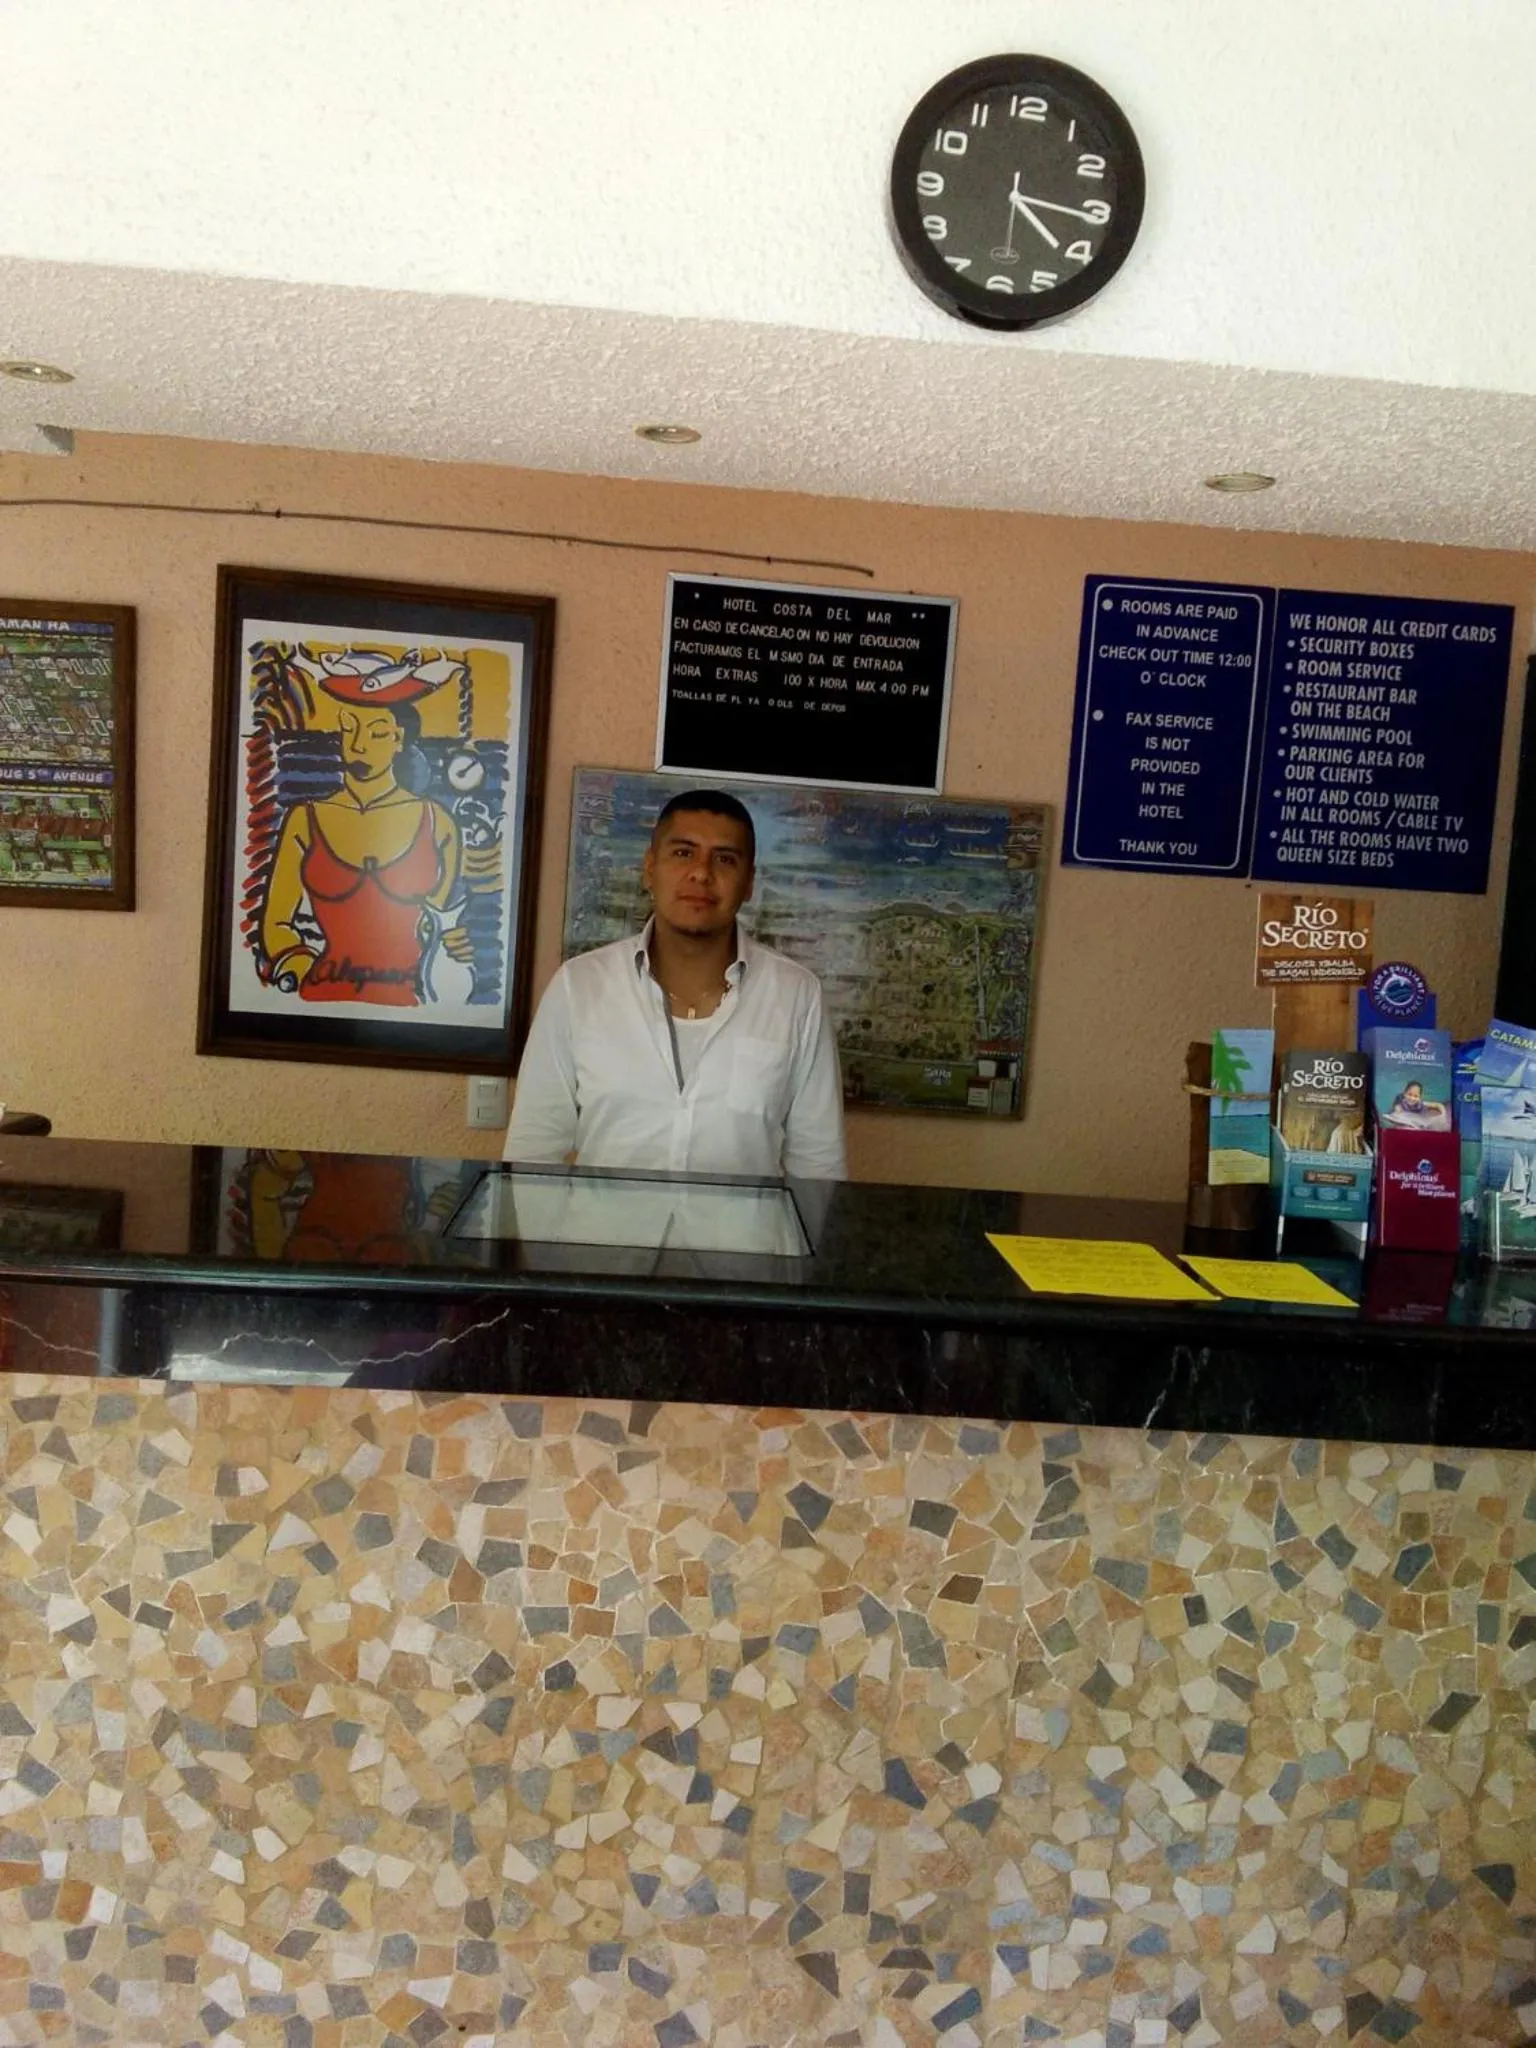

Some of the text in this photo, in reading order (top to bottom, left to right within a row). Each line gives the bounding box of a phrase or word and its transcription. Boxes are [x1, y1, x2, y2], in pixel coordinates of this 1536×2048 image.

[972, 103, 988, 128] 11
[1010, 95, 1048, 122] 12
[935, 128, 968, 156] 10
[1068, 120, 1075, 142] 1
[1077, 154, 1106, 178] 2
[917, 171, 944, 196] 9
[1083, 200, 1111, 224] 3
[923, 215, 947, 240] 8
[1064, 240, 1092, 265] 4
[1030, 270, 1058, 292] 5
[723, 598, 891, 624] HOTEL COSTA DEL MAR
[1121, 599, 1238, 620] ROOMS ARE PAID
[674, 617, 688, 630] EN
[693, 619, 721, 633] CASO
[726, 622, 738, 635] DE
[816, 630, 830, 644] NO
[834, 631, 852, 644] HAY
[860, 634, 920, 650] DEVOLUCION
[1137, 624, 1218, 643] IN ADVANCE
[1290, 614, 1496, 643] WE HONOR ALL CREDIT CARDS
[674, 642, 742, 658] FACTURAMOS
[748, 648, 761, 661] EL
[808, 652, 824, 665] DIA
[832, 654, 845, 668] DE
[854, 656, 904, 672] ENTRADA
[1099, 645, 1252, 668] CHECK OUT TIME 12:00
[1300, 637, 1415, 660] SECURITY BOXES
[673, 664, 702, 678] HORA
[716, 666, 758, 684] EXTRAS
[784, 672, 802, 686] 100
[808, 675, 815, 688] X
[820, 676, 848, 690] HORA
[912, 684, 930, 697] PM
[1159, 673, 1206, 688] CLOCK
[1298, 660, 1402, 681] ROOM SERVICE
[1296, 682, 1418, 704] RESTAURANT BAR
[1126, 712, 1214, 730] FAX SERVICE
[1290, 701, 1391, 722] ON THE BEACH
[1146, 737, 1190, 752] IS NOT
[1292, 723, 1412, 746] SWIMMING POOL
[1131, 758, 1200, 774] PROVIDED
[1290, 746, 1425, 768] PARKING AREA FOR
[53, 772, 103, 783] AVENUE
[1284, 764, 1373, 784] OUR CLIENTS
[1142, 782, 1185, 796] IN THE
[1286, 787, 1440, 810] HOT AND COLD WATER
[1138, 804, 1184, 820] HOTEL
[1281, 806, 1296, 821] IN
[1301, 807, 1323, 822] ALL
[1329, 809, 1380, 826] ROOMS
[1444, 816, 1464, 832] TV
[1120, 838, 1198, 856] THANK YOU
[1282, 828, 1468, 854] ALL THE ROOMS HAVE TWO
[1277, 846, 1394, 868] QUEEN SIZE BEDS
